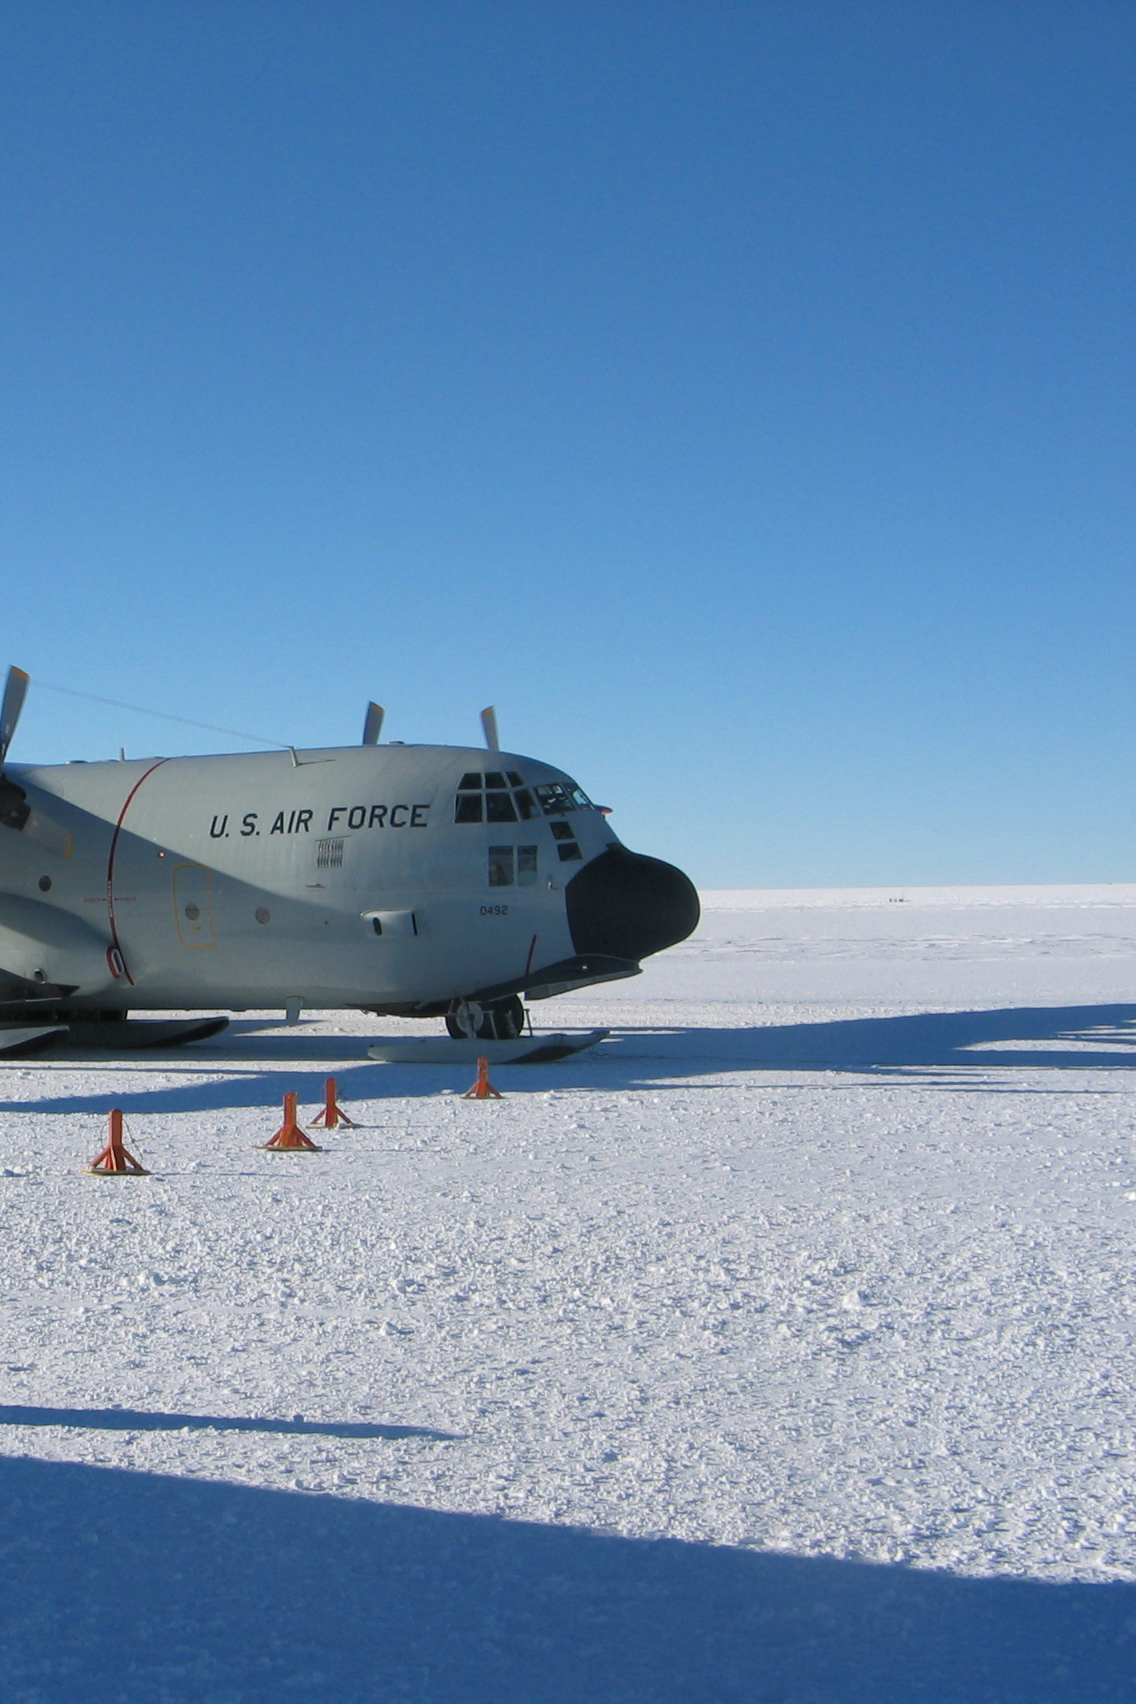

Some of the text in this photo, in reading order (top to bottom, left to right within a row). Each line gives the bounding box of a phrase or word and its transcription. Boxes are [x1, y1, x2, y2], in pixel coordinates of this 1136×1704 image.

[269, 808, 314, 835] AIR
[327, 803, 431, 832] FORCE
[479, 905, 509, 916] 0492
